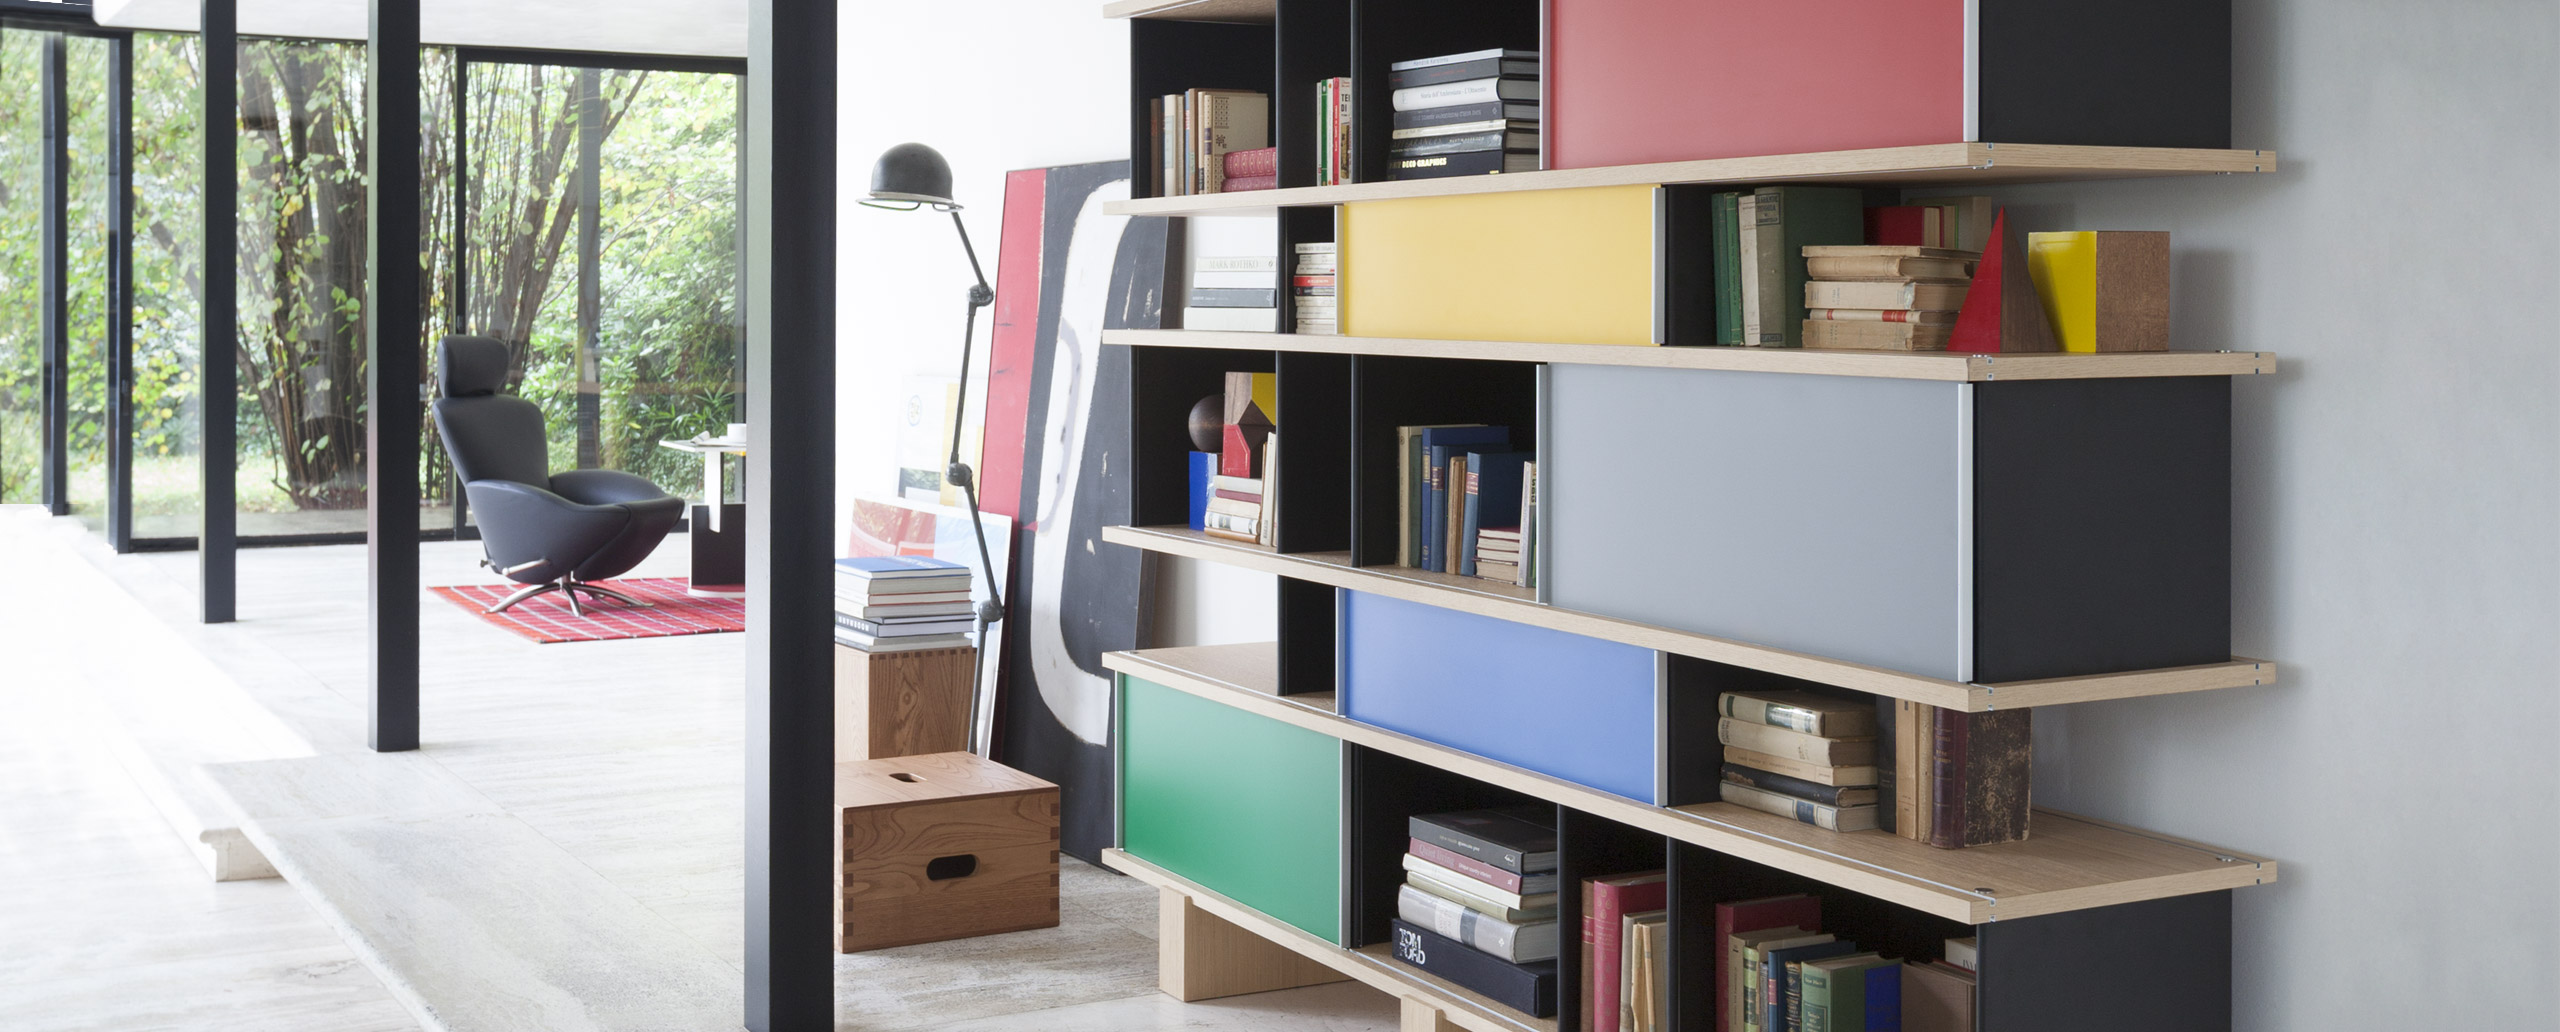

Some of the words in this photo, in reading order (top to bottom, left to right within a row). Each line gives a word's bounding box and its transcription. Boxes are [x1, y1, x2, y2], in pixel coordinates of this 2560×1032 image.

[1402, 159, 1416, 169] DECO
[1417, 157, 1447, 168] GRAPHICS
[1210, 259, 1229, 270] MARK
[1230, 259, 1259, 270] ROTHKO
[1399, 927, 1421, 952] TOM
[1400, 941, 1426, 965] FORD
